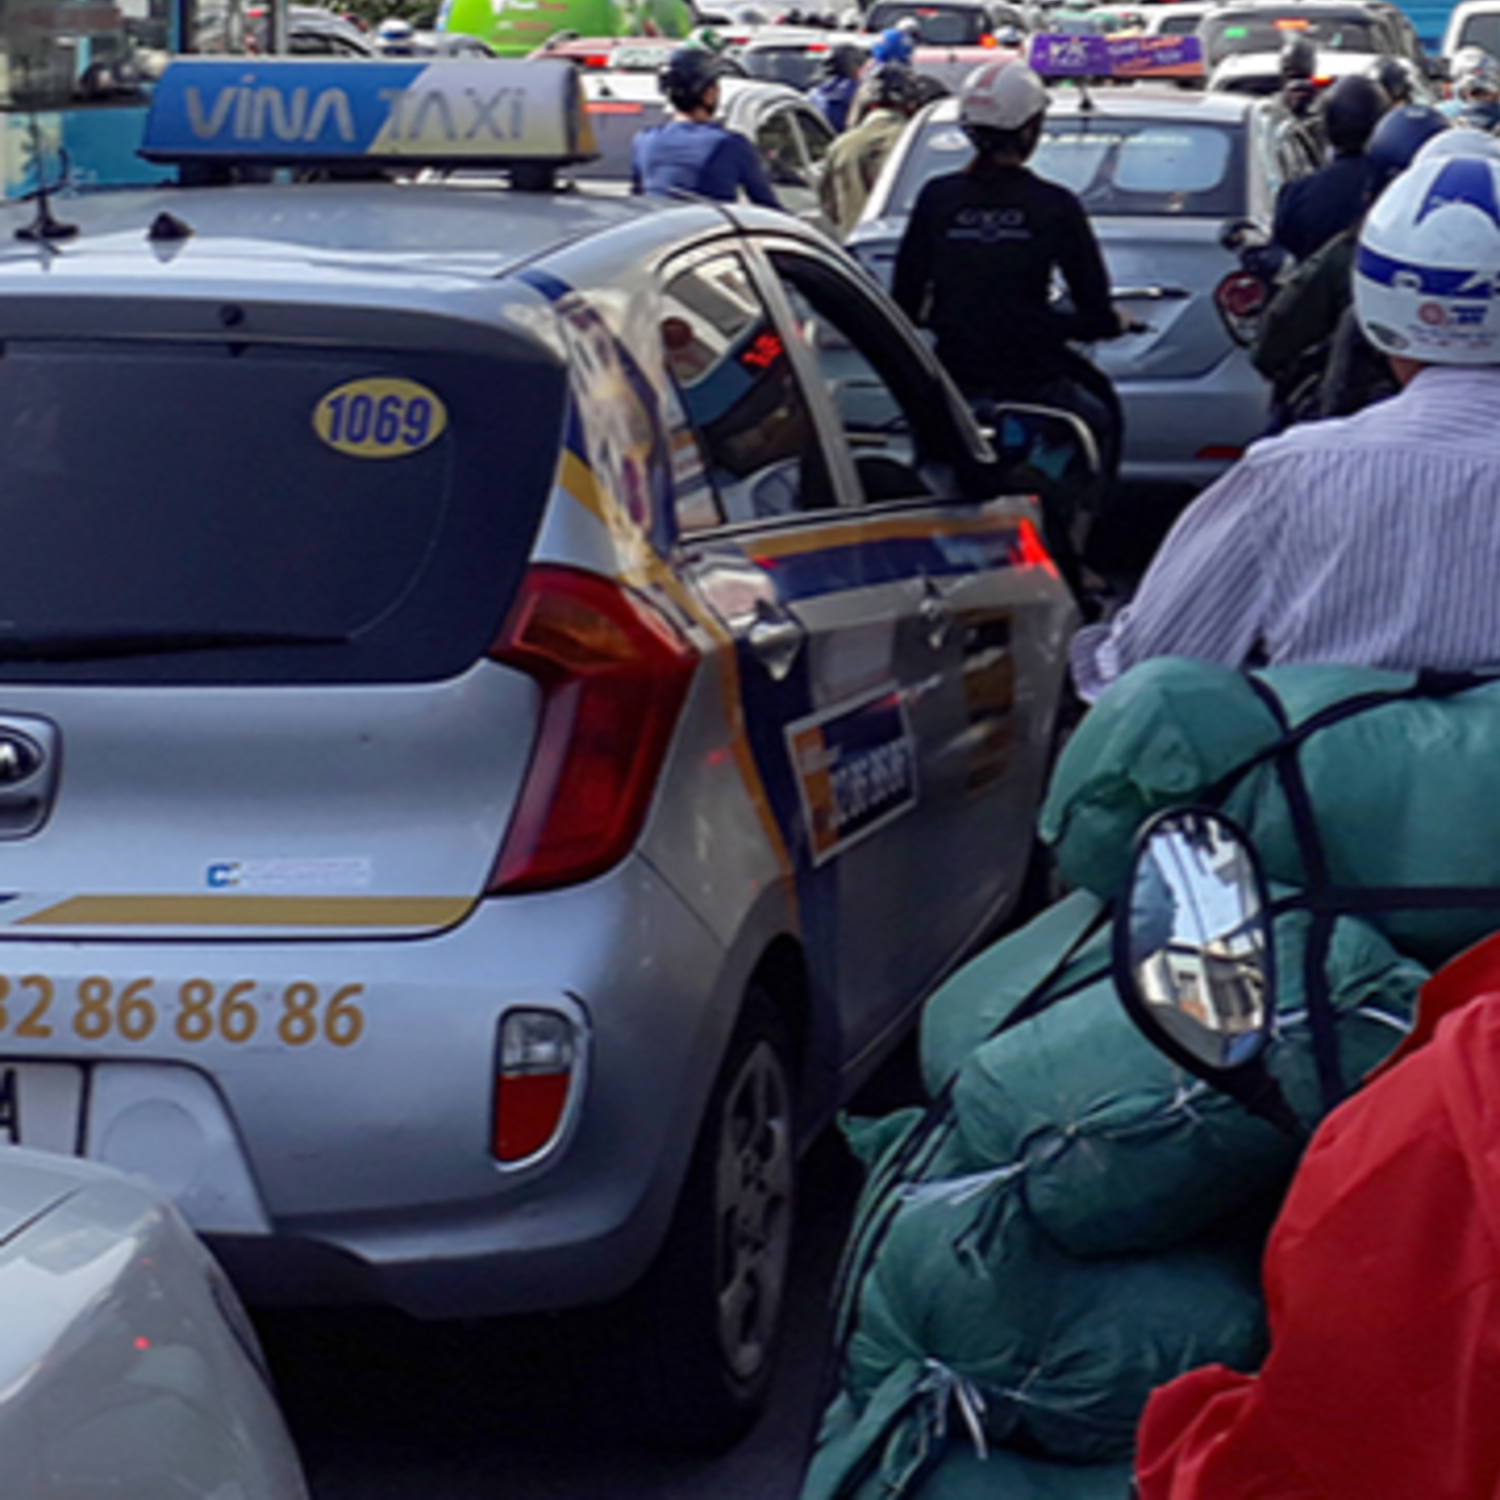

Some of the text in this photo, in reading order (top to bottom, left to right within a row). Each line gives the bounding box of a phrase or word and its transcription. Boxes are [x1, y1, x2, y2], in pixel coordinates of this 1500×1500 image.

[327, 392, 433, 447] 1069
[72, 976, 156, 1042] 86
[174, 978, 260, 1043] 86
[277, 980, 366, 1047] 86
